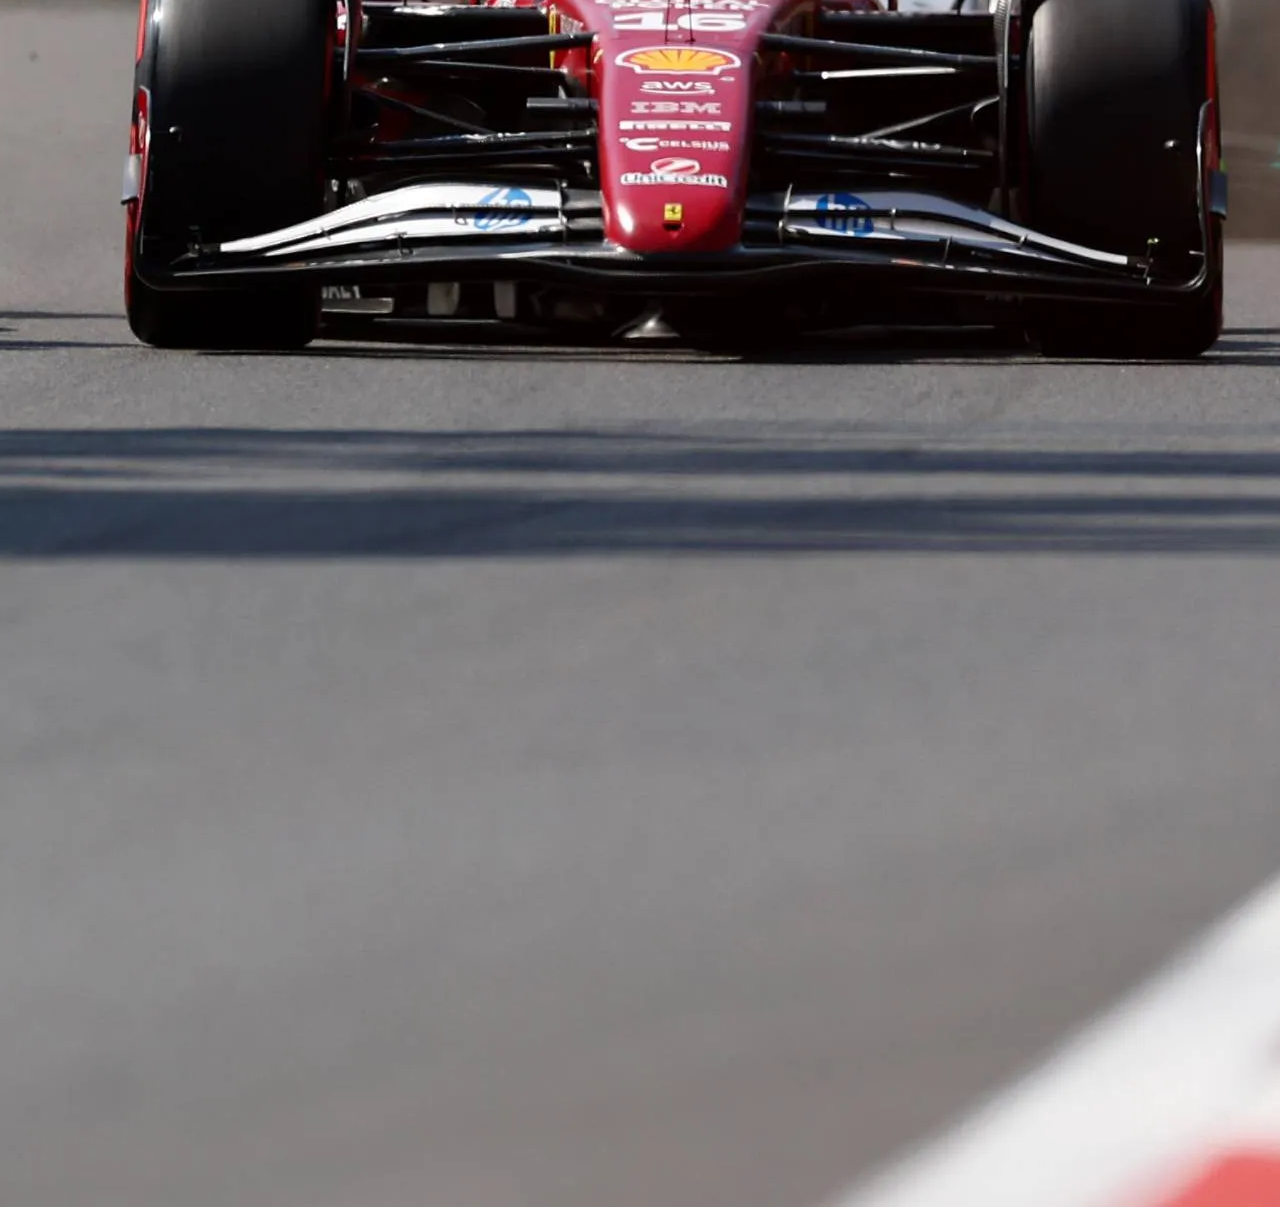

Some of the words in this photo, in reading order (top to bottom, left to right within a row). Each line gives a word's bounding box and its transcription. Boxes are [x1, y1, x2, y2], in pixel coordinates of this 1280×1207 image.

[613, 11, 747, 32] 16
[641, 81, 713, 92] aws
[631, 101, 722, 114] IBM
